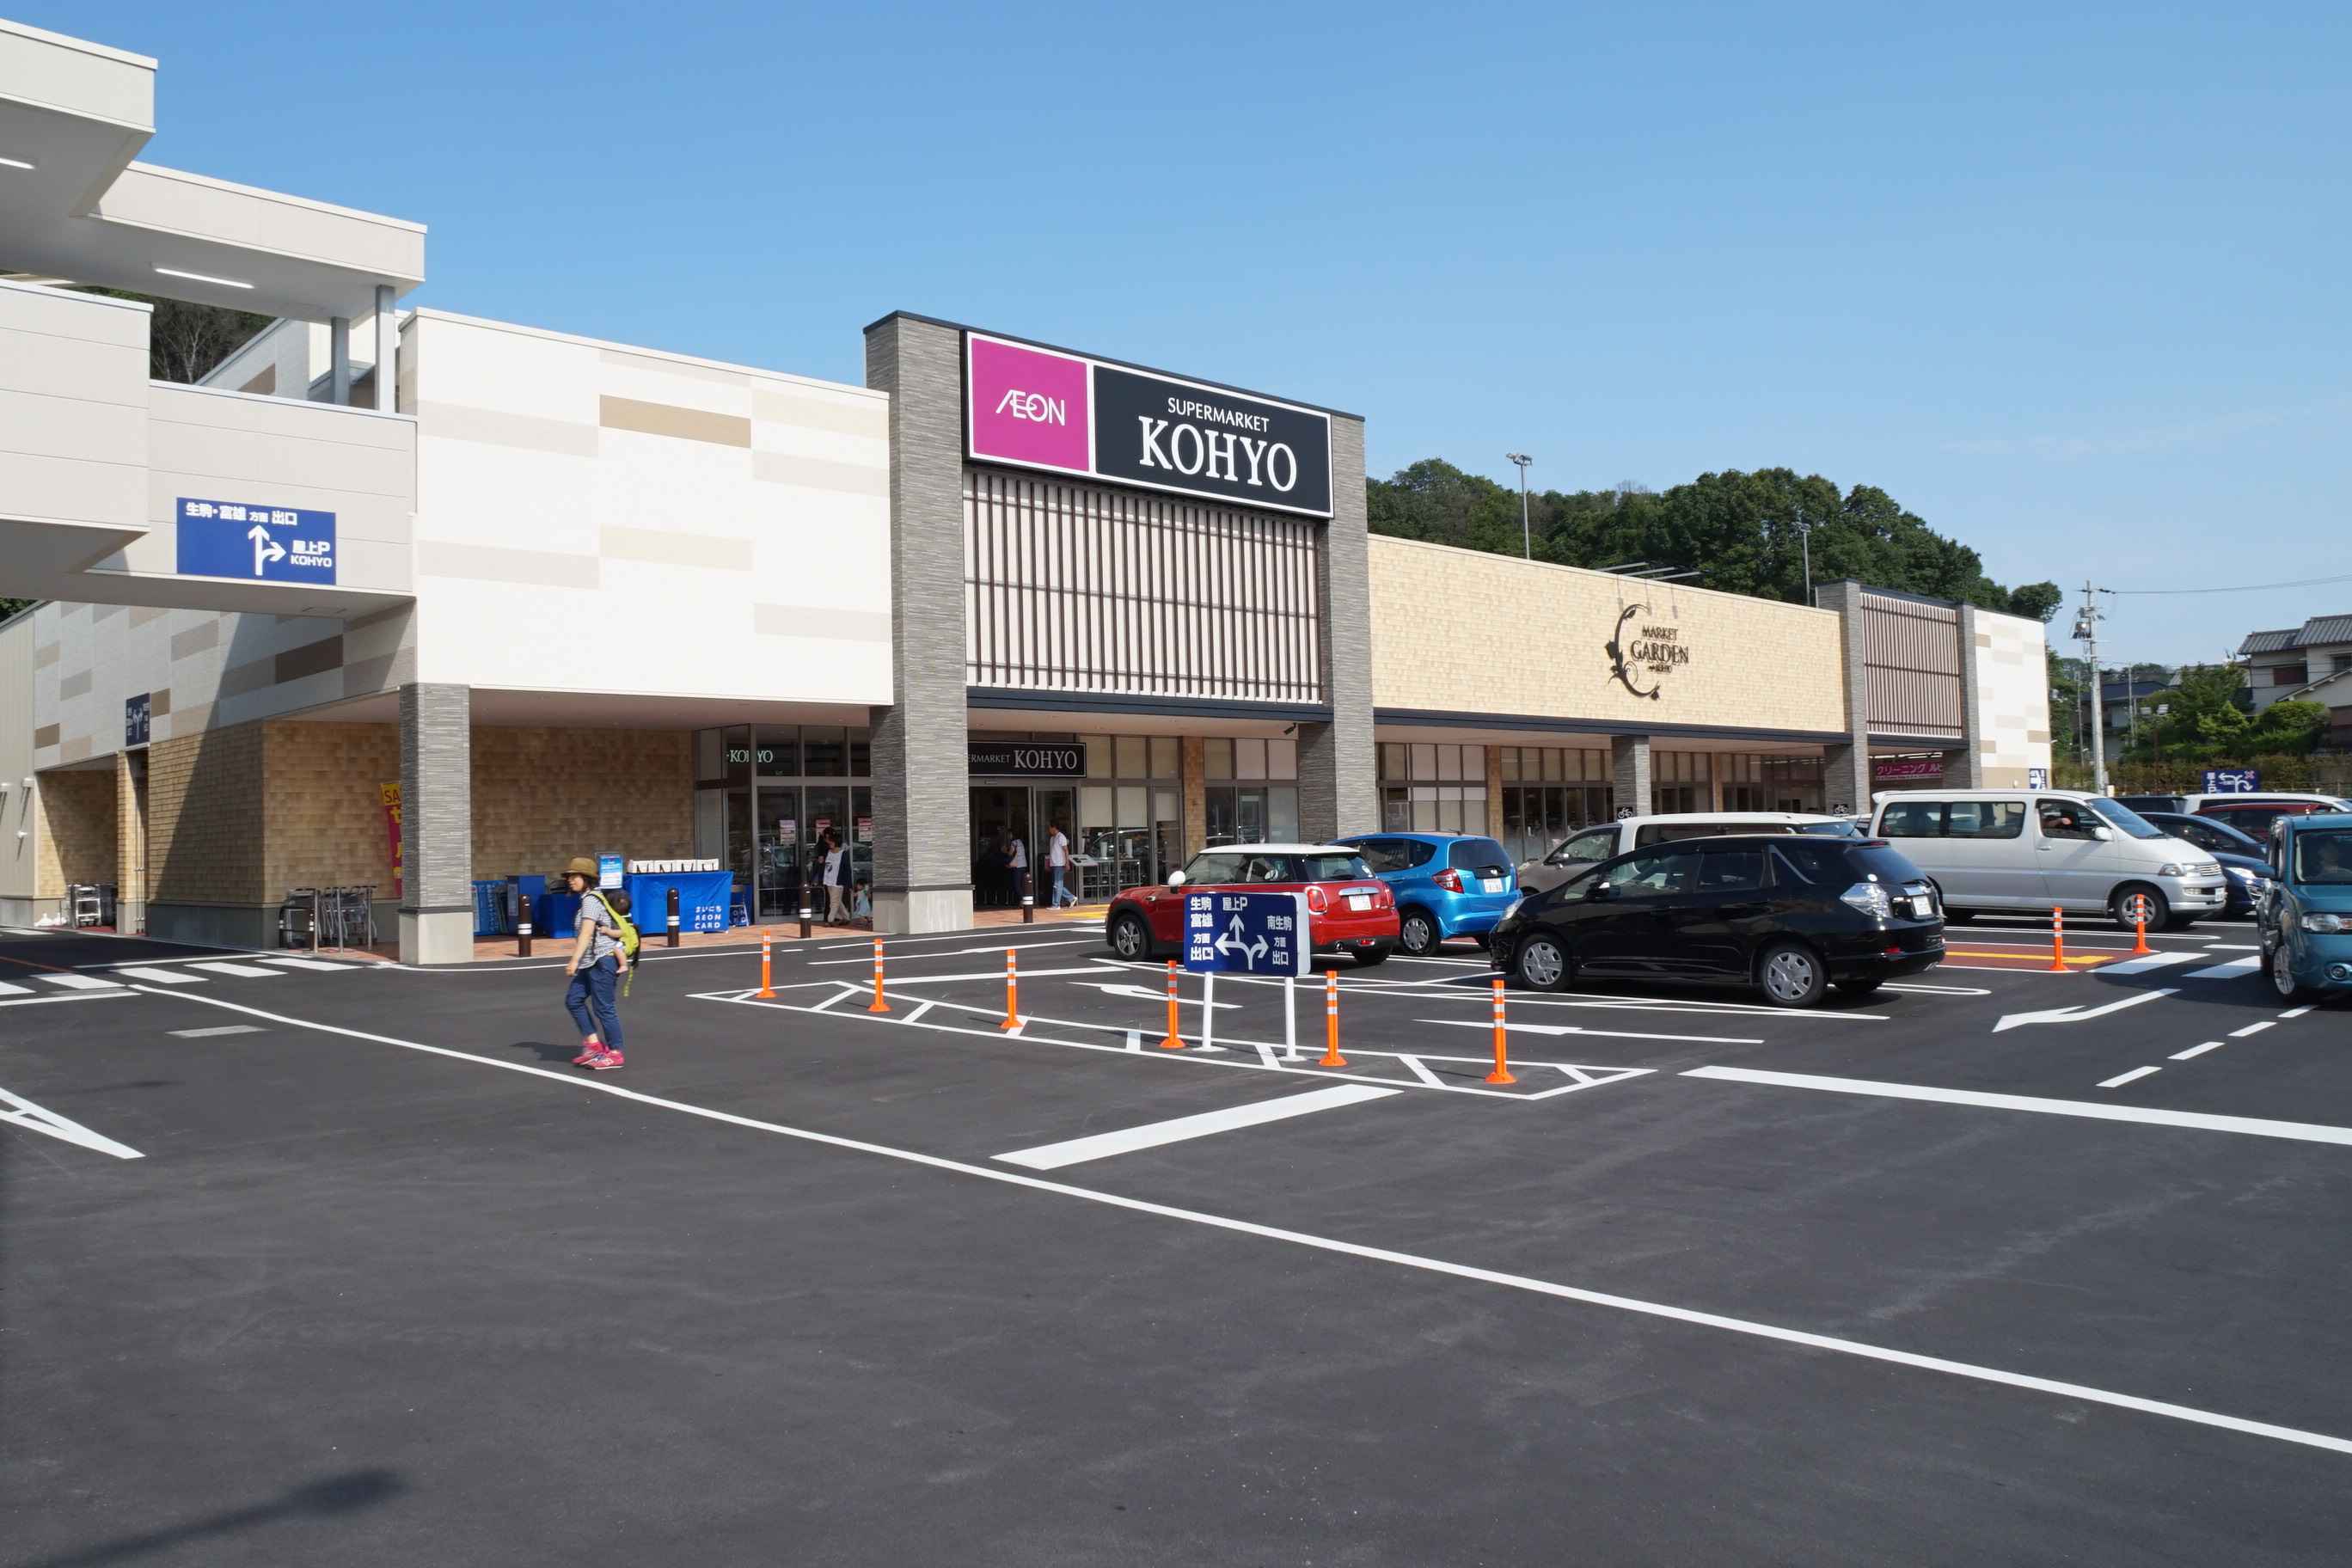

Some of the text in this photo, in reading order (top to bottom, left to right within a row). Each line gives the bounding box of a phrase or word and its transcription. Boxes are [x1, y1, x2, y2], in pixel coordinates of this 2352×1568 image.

[1167, 397, 1270, 432] SUPERMARKET
[1138, 415, 1297, 492] KOHYO
[249, 511, 269, 524] 方面
[272, 510, 297, 526] 出口
[291, 554, 333, 567] KOHYO
[1642, 624, 1678, 641] MARKET
[1631, 640, 1689, 665] GARDEN
[1014, 750, 1078, 769] KOHYO
[1877, 763, 1926, 775] クリーニング
[1190, 897, 1212, 911] 生駒
[1222, 897, 1248, 911] 屋上P
[1193, 933, 1211, 944] 方面
[1190, 946, 1214, 961] 出口
[1272, 950, 1289, 965] 出口
